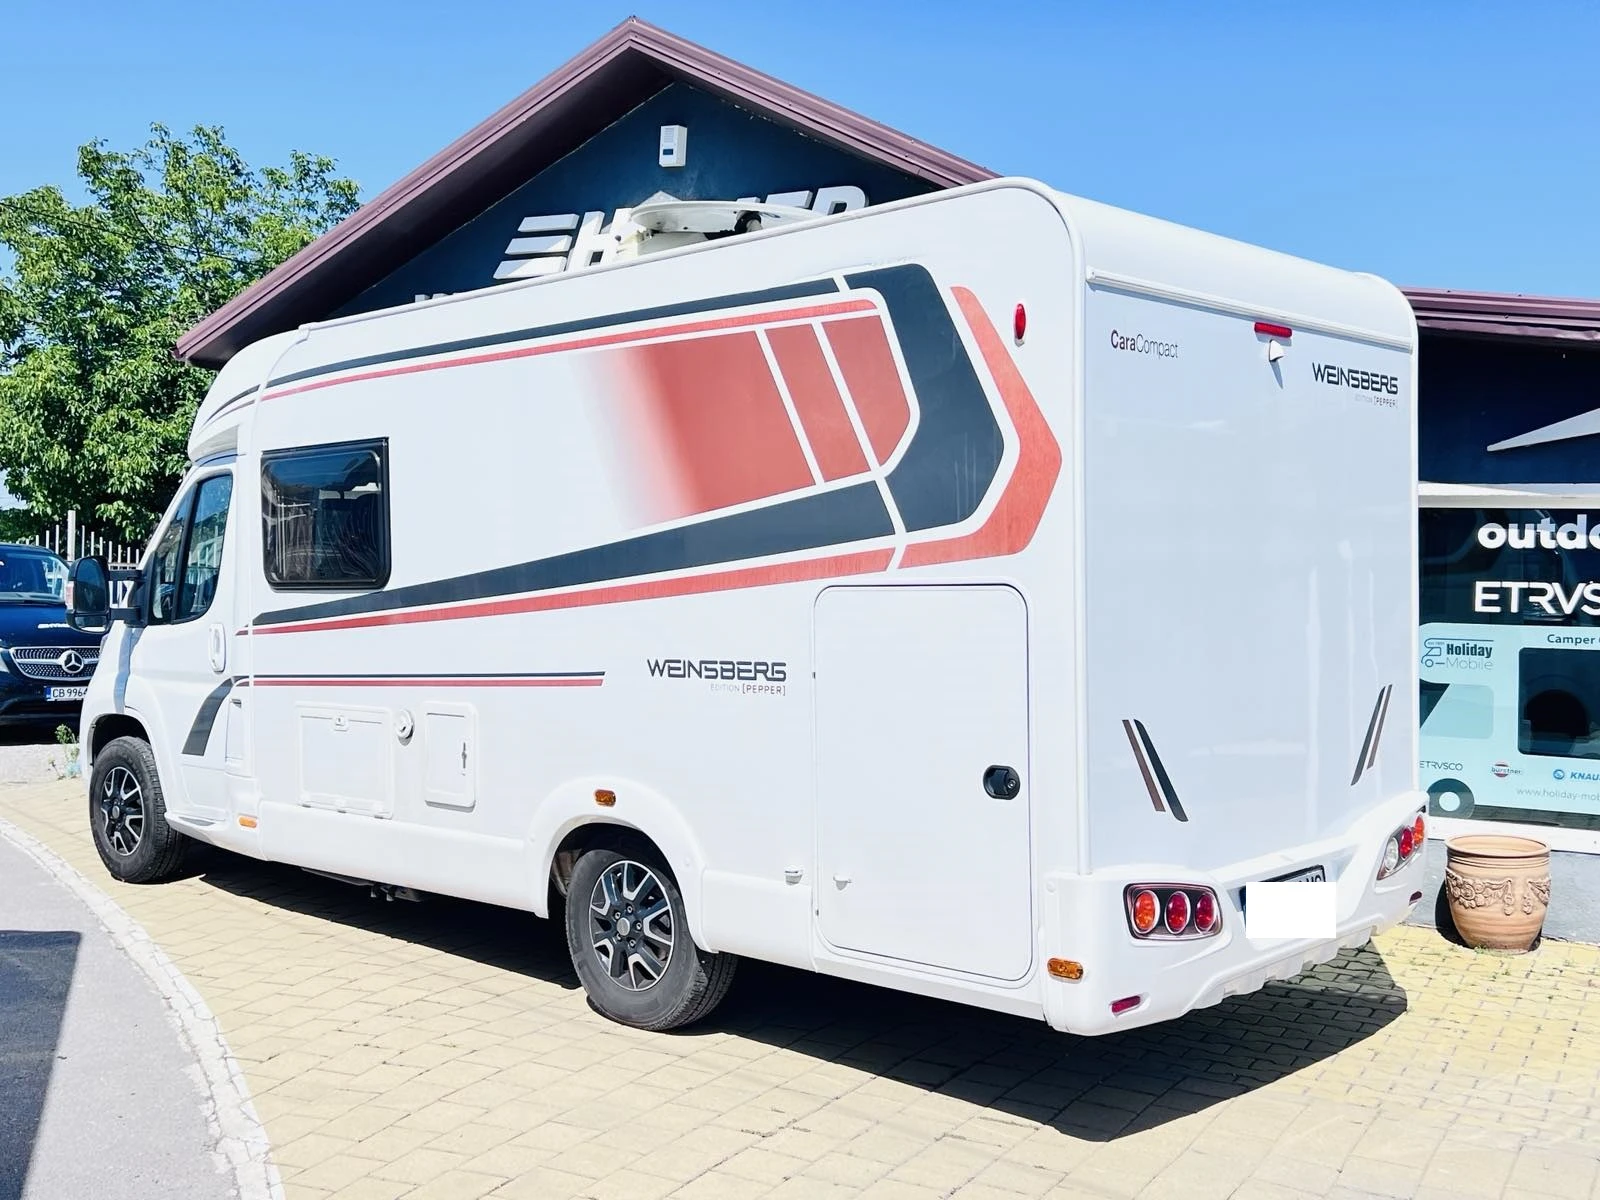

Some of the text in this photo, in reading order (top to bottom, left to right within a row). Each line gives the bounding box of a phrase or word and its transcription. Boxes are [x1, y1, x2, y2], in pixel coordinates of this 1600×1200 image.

[1110, 329, 1178, 359] CaraCompact
[1311, 362, 1398, 395] WEINSBERG
[1547, 634, 1596, 646] Camper
[1446, 643, 1493, 659] Holiday
[646, 658, 787, 682] WEINSBERG
[1446, 657, 1493, 671] Mobile
[1570, 772, 1600, 781] KNAU
